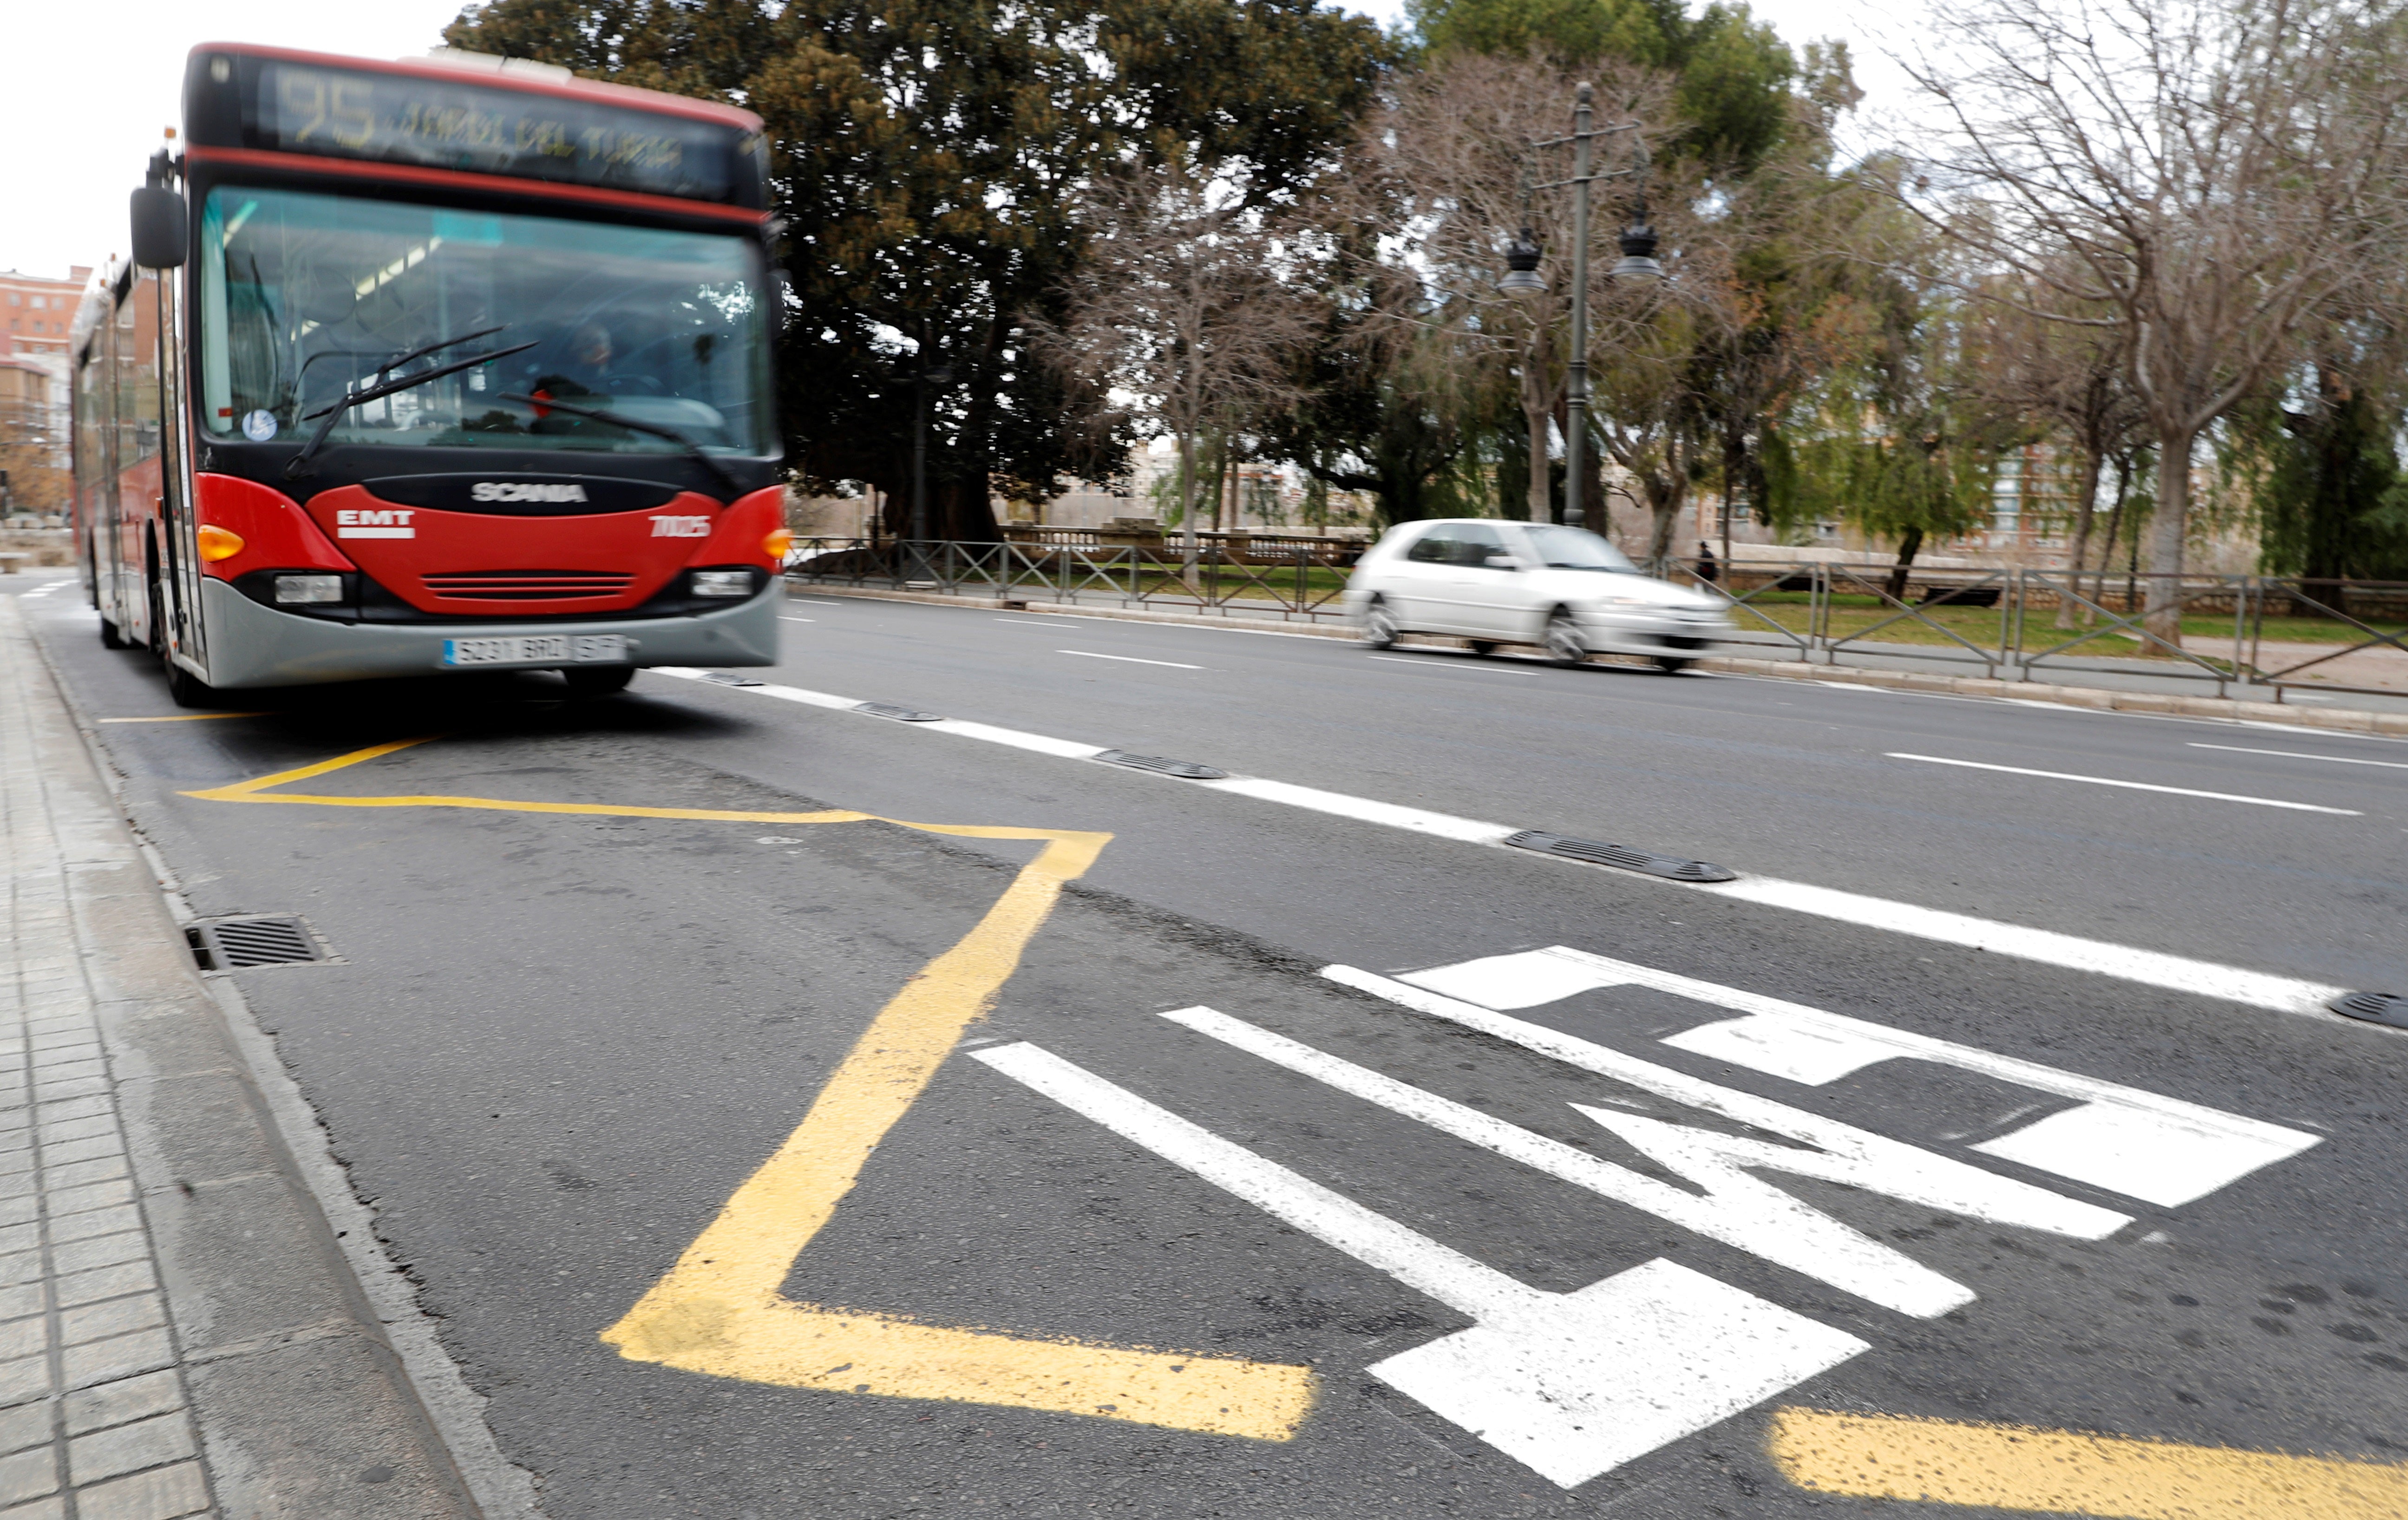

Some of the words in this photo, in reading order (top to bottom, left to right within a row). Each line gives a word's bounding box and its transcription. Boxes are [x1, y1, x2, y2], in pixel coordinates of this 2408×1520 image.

[281, 70, 375, 151] 95
[471, 482, 589, 502] SCANIA
[336, 510, 416, 525] EMT
